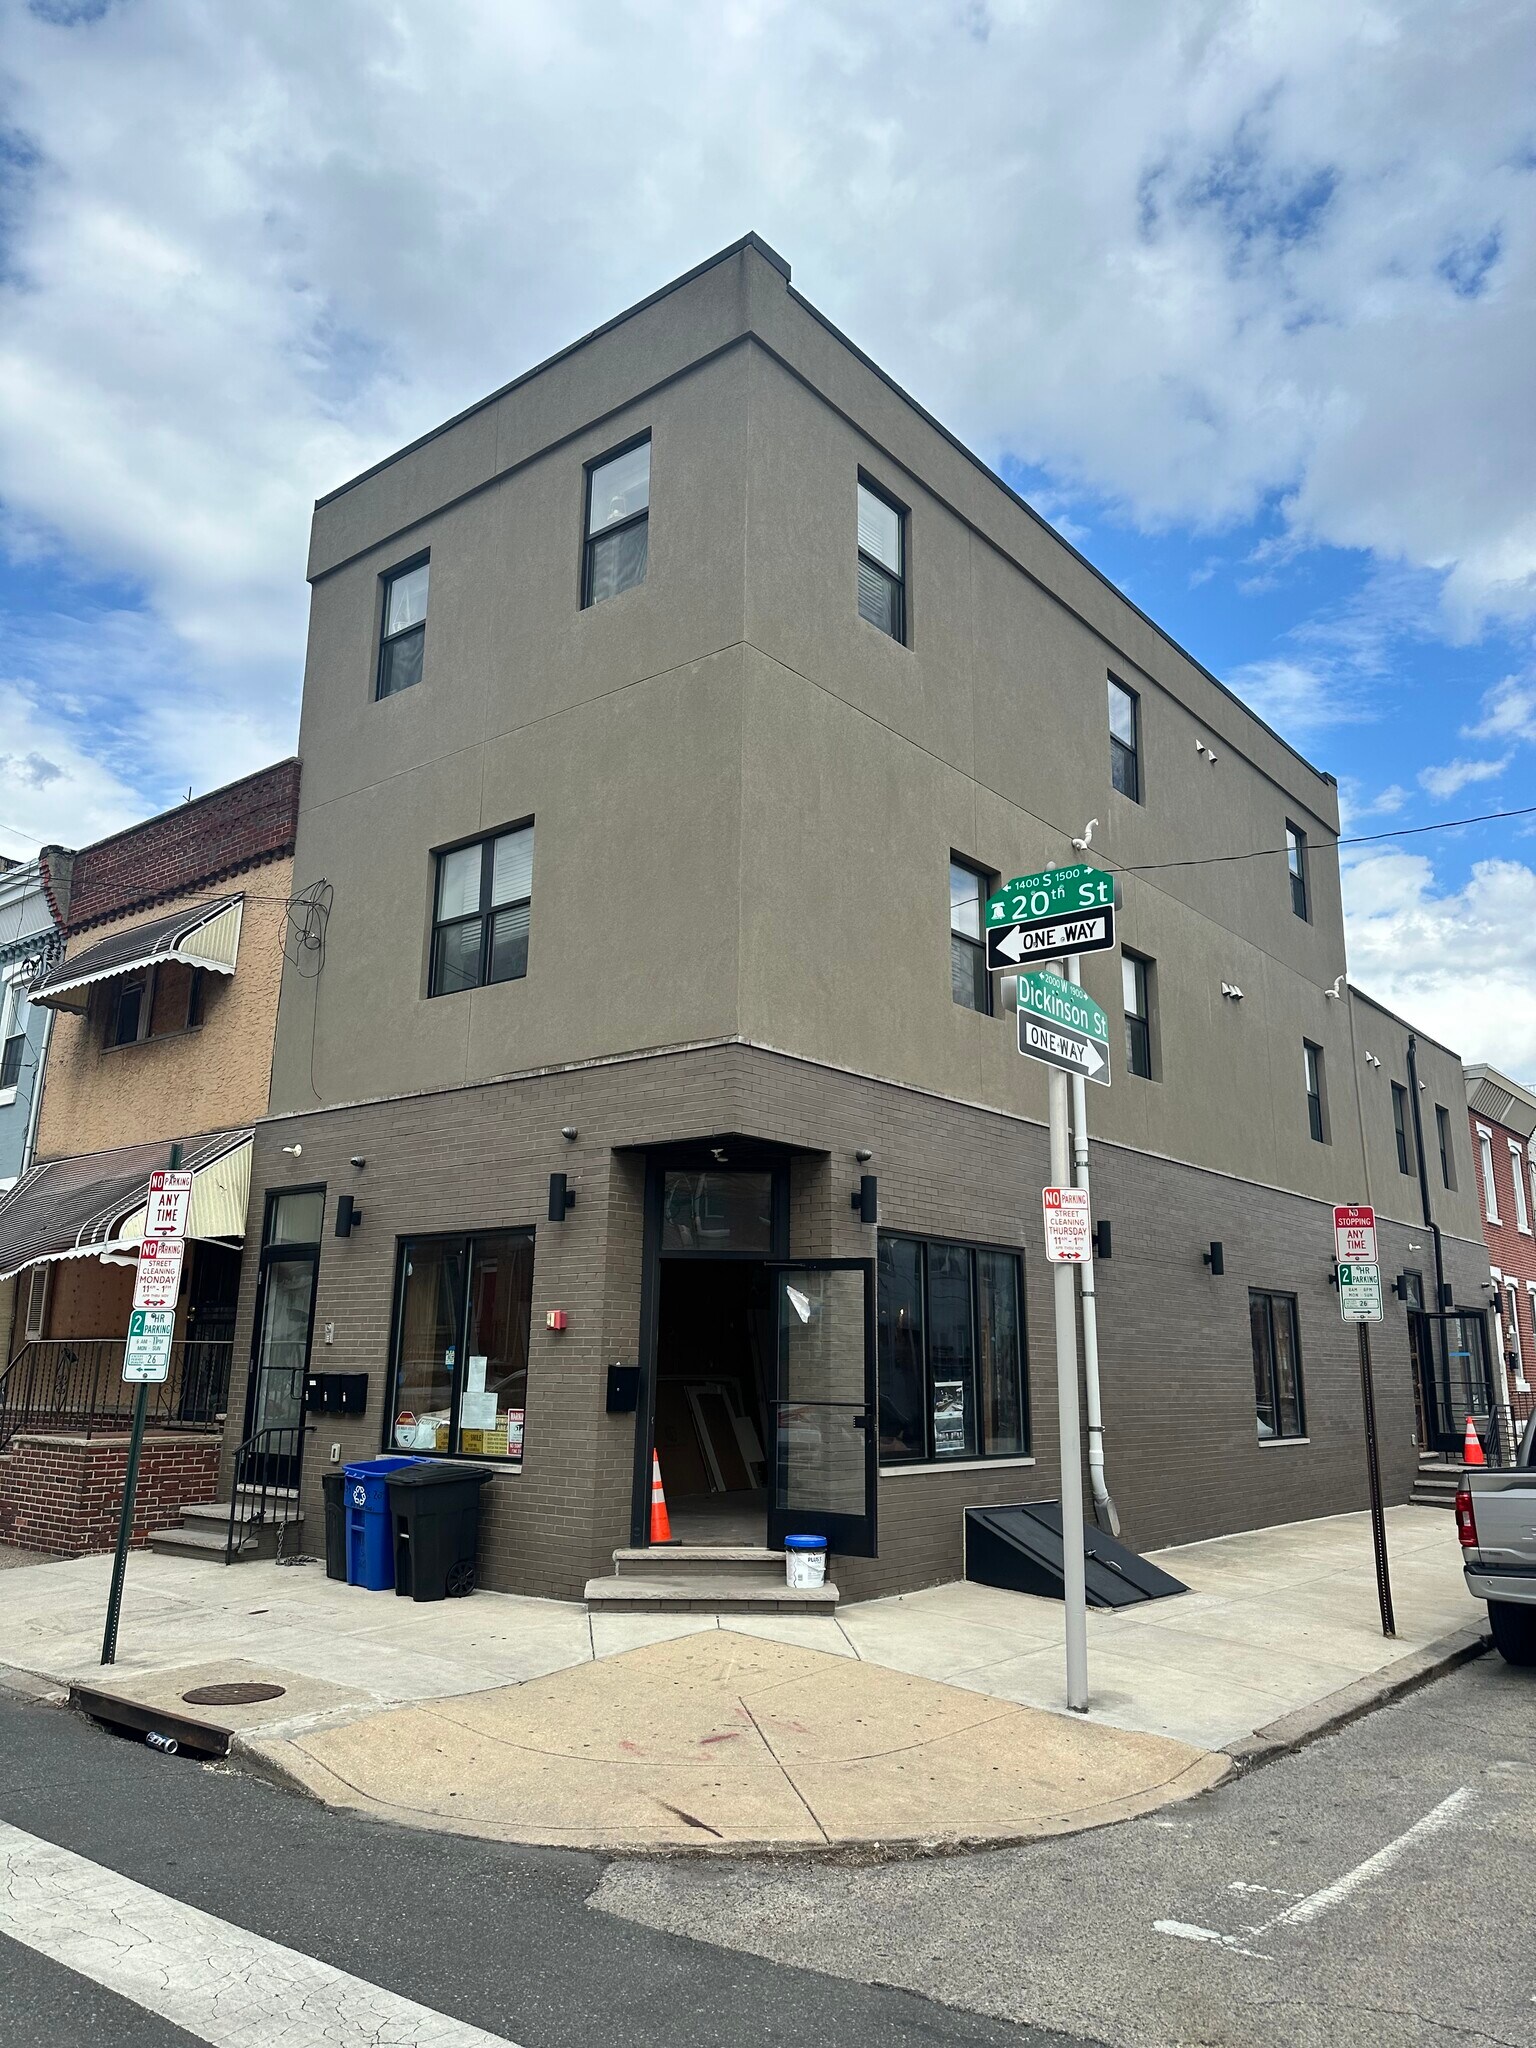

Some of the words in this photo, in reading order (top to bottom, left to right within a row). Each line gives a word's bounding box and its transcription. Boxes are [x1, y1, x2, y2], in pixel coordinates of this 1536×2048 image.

[1015, 876, 1040, 890] 1400
[1042, 874, 1052, 886] S
[1055, 868, 1080, 882] 1500
[1011, 886, 1066, 920] 20th
[1078, 881, 1108, 906] St
[1023, 930, 1056, 950] ONE
[1064, 921, 1097, 942] WAY
[1045, 974, 1060, 988] 2000
[1061, 980, 1068, 993] W
[1070, 986, 1084, 1000] 1900
[1019, 976, 1088, 1029] Dickinson
[1094, 1014, 1107, 1038] St
[1031, 1028, 1056, 1052] ONE
[1060, 1038, 1085, 1063] WAY
[152, 1176, 162, 1188] NO
[165, 1177, 190, 1186] PARKING
[159, 1194, 180, 1206] ANY
[1046, 1192, 1060, 1206] NO
[1062, 1194, 1086, 1204] PARKING
[157, 1209, 178, 1221] TIME
[1049, 1227, 1087, 1236] THURSDAY
[1348, 1230, 1364, 1238] ANY
[142, 1243, 156, 1256] NO
[158, 1246, 180, 1254] PARKING
[1347, 1240, 1366, 1249] TIME
[1342, 1268, 1350, 1282] 2
[133, 1315, 141, 1333] 2
[154, 1314, 165, 1323] HR
[144, 1325, 170, 1334] PARKING
[147, 1355, 156, 1364] 26
